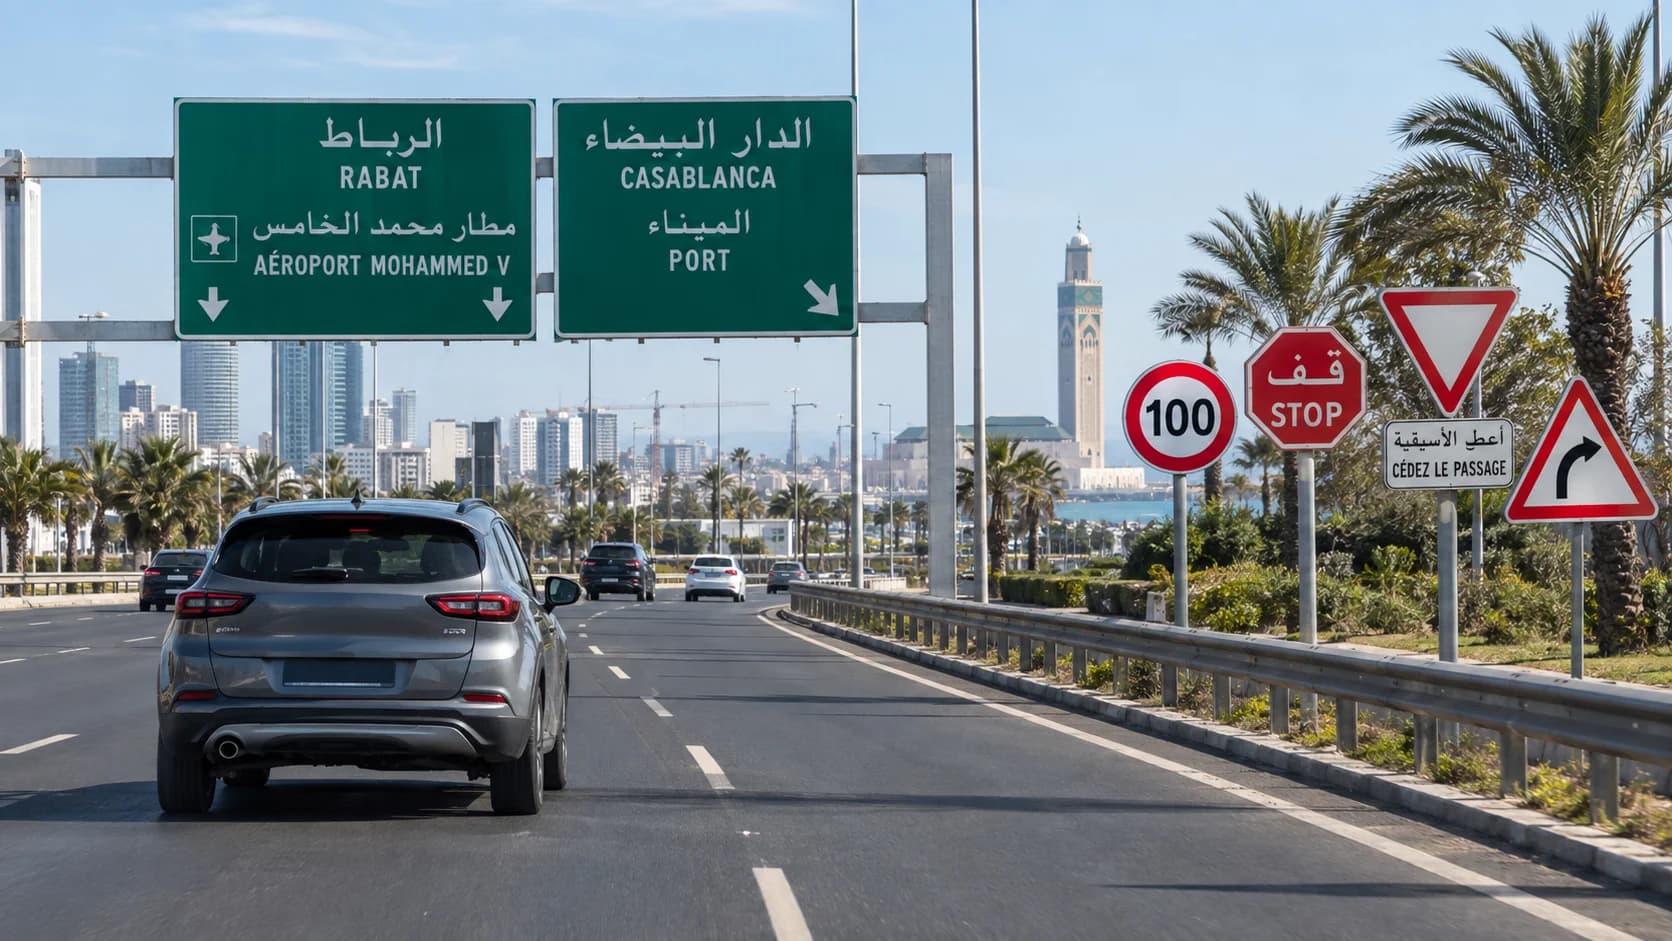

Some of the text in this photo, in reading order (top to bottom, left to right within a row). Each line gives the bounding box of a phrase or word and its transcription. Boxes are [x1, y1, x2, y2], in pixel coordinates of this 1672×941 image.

[319, 117, 442, 158] الرباط
[586, 117, 811, 158] الدار البيضاء
[340, 166, 422, 189] RABAT
[620, 166, 777, 189] CASABLANCA
[253, 211, 516, 242] مطار محمد الخامس
[649, 209, 750, 242] الميناء
[253, 250, 510, 276] AÉROPORT MOHAMMED V
[669, 249, 730, 272] PORT
[1268, 350, 1345, 386] قف
[1146, 398, 1215, 437] 100
[1271, 402, 1343, 428] STOP
[1392, 459, 1507, 478] CÉDEZ LE PASSAGE
